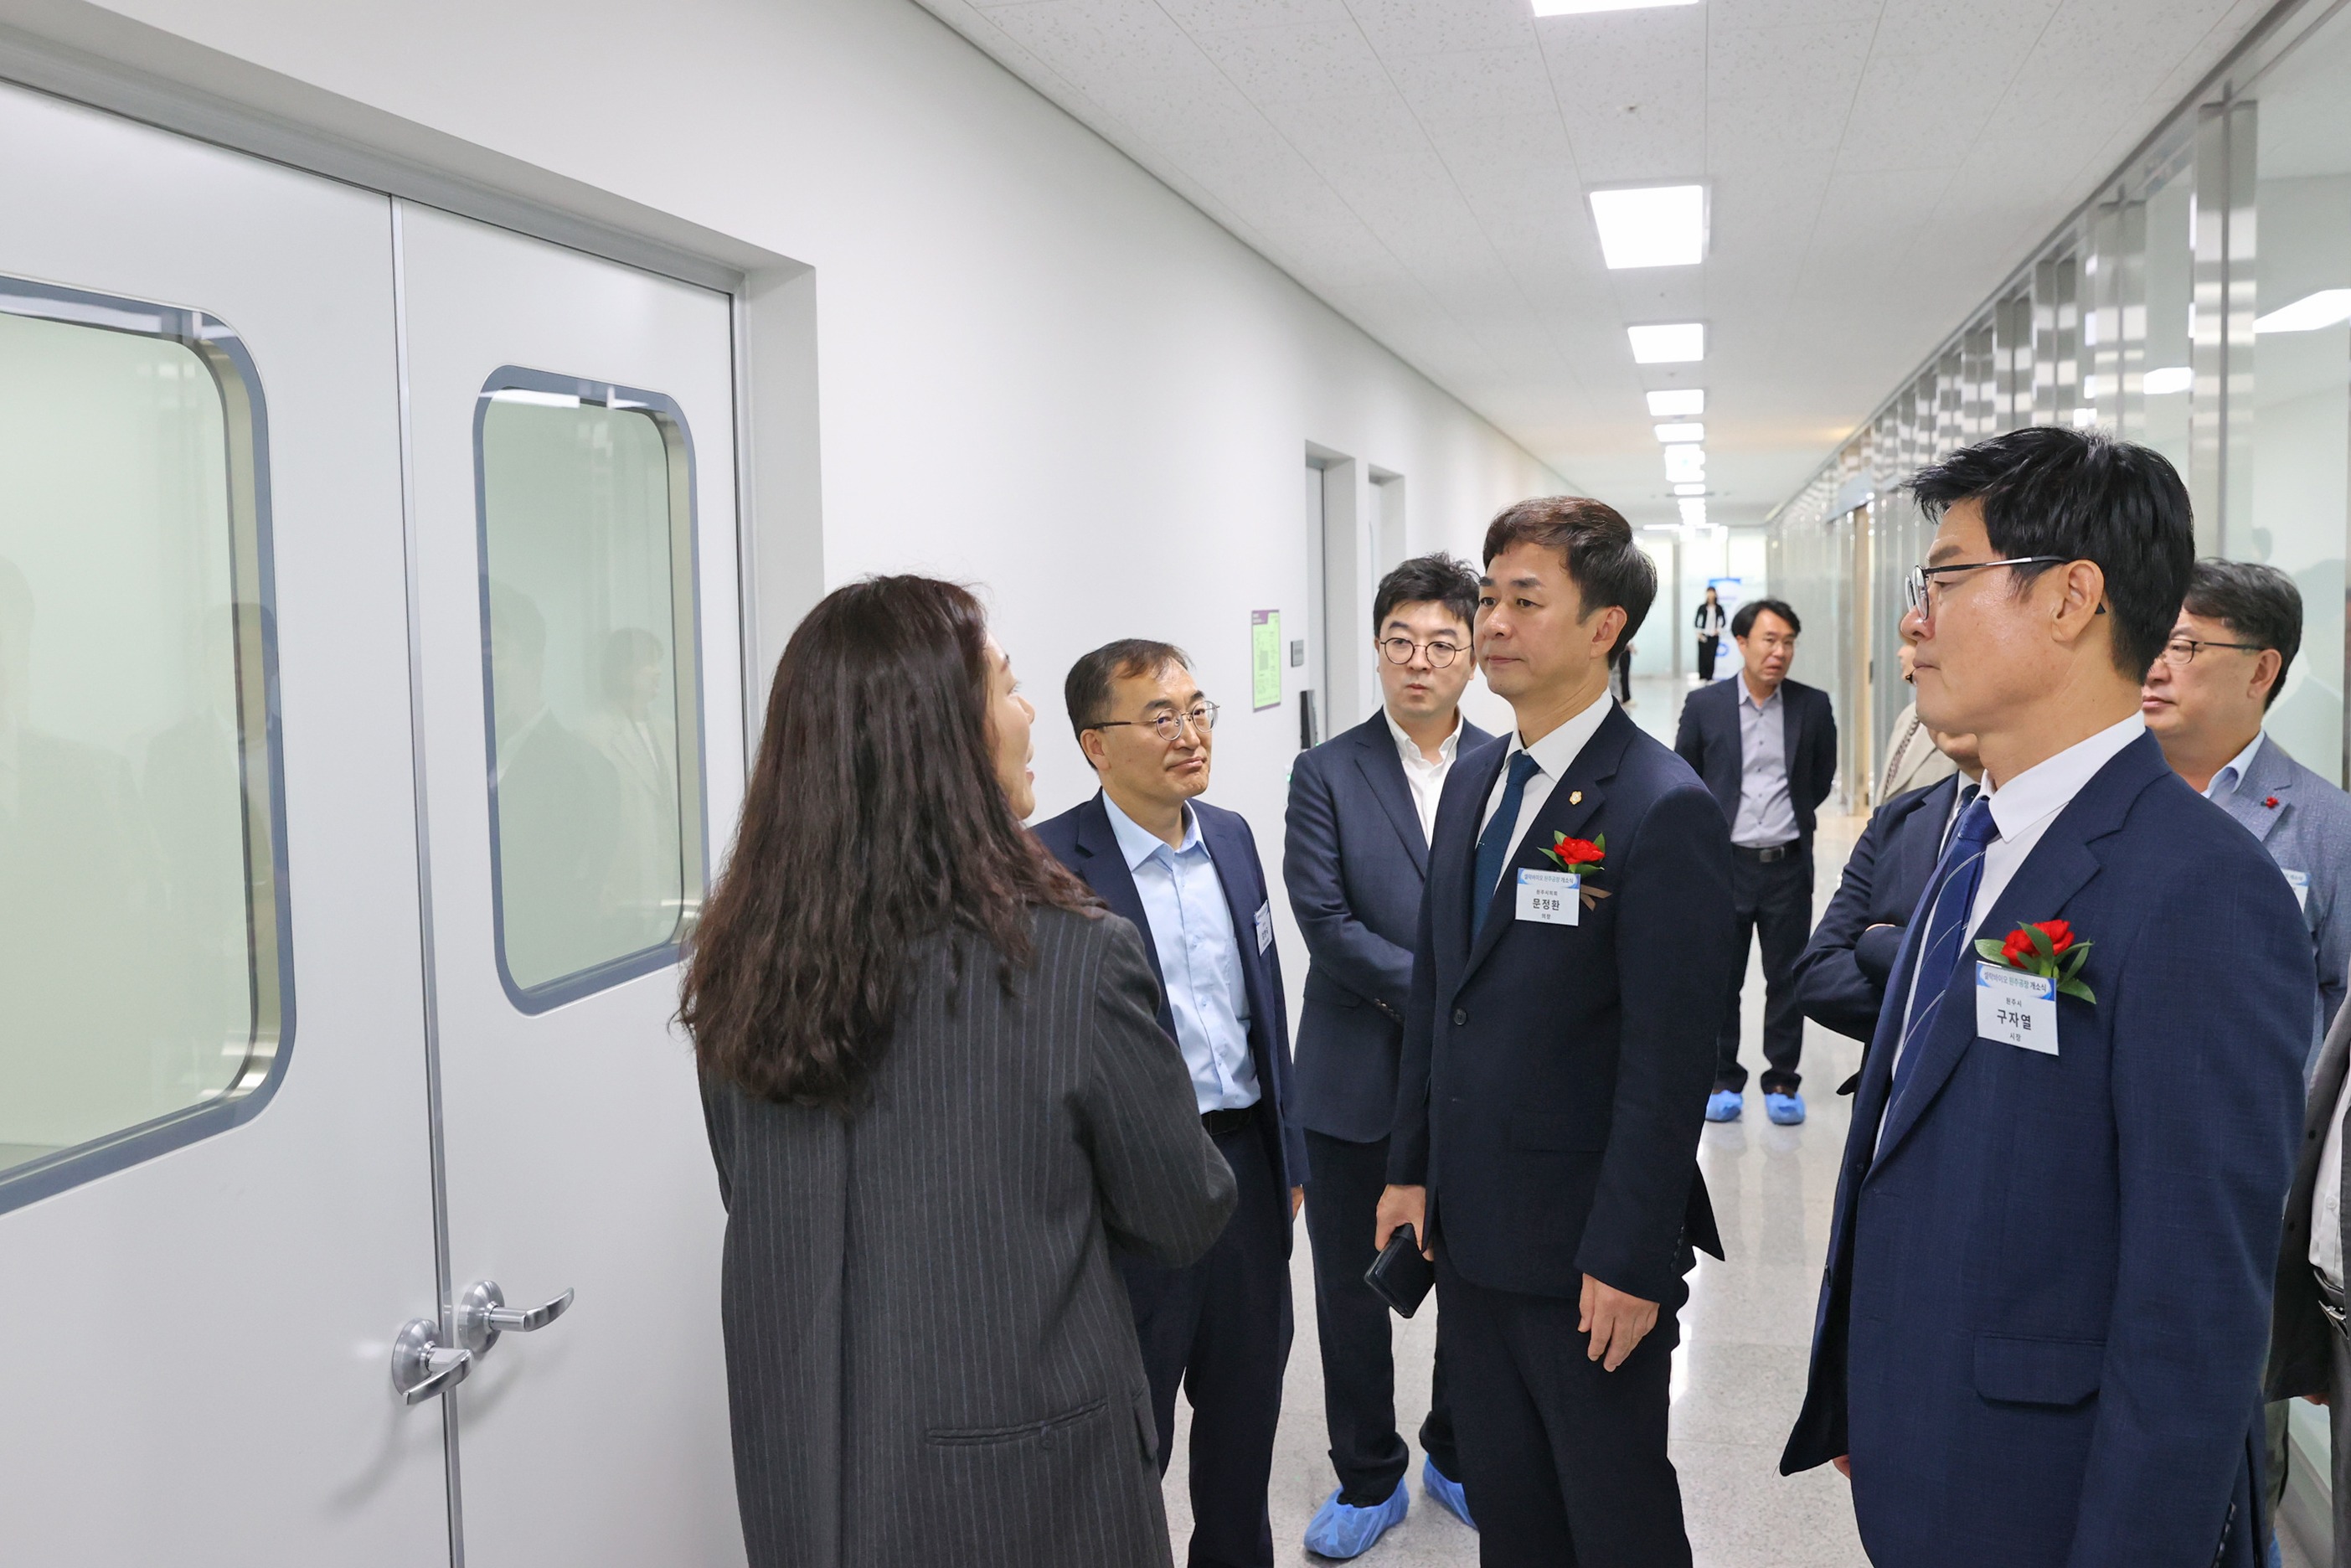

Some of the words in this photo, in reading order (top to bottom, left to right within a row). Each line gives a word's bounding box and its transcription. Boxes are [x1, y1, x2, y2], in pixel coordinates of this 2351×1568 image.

[1533, 898, 1560, 910] 문정환
[2029, 981, 2047, 993] 개소식
[2006, 997, 2022, 1008] 원주시
[1997, 1008, 2032, 1031] 구자열
[2009, 1032, 2022, 1042] 시장
